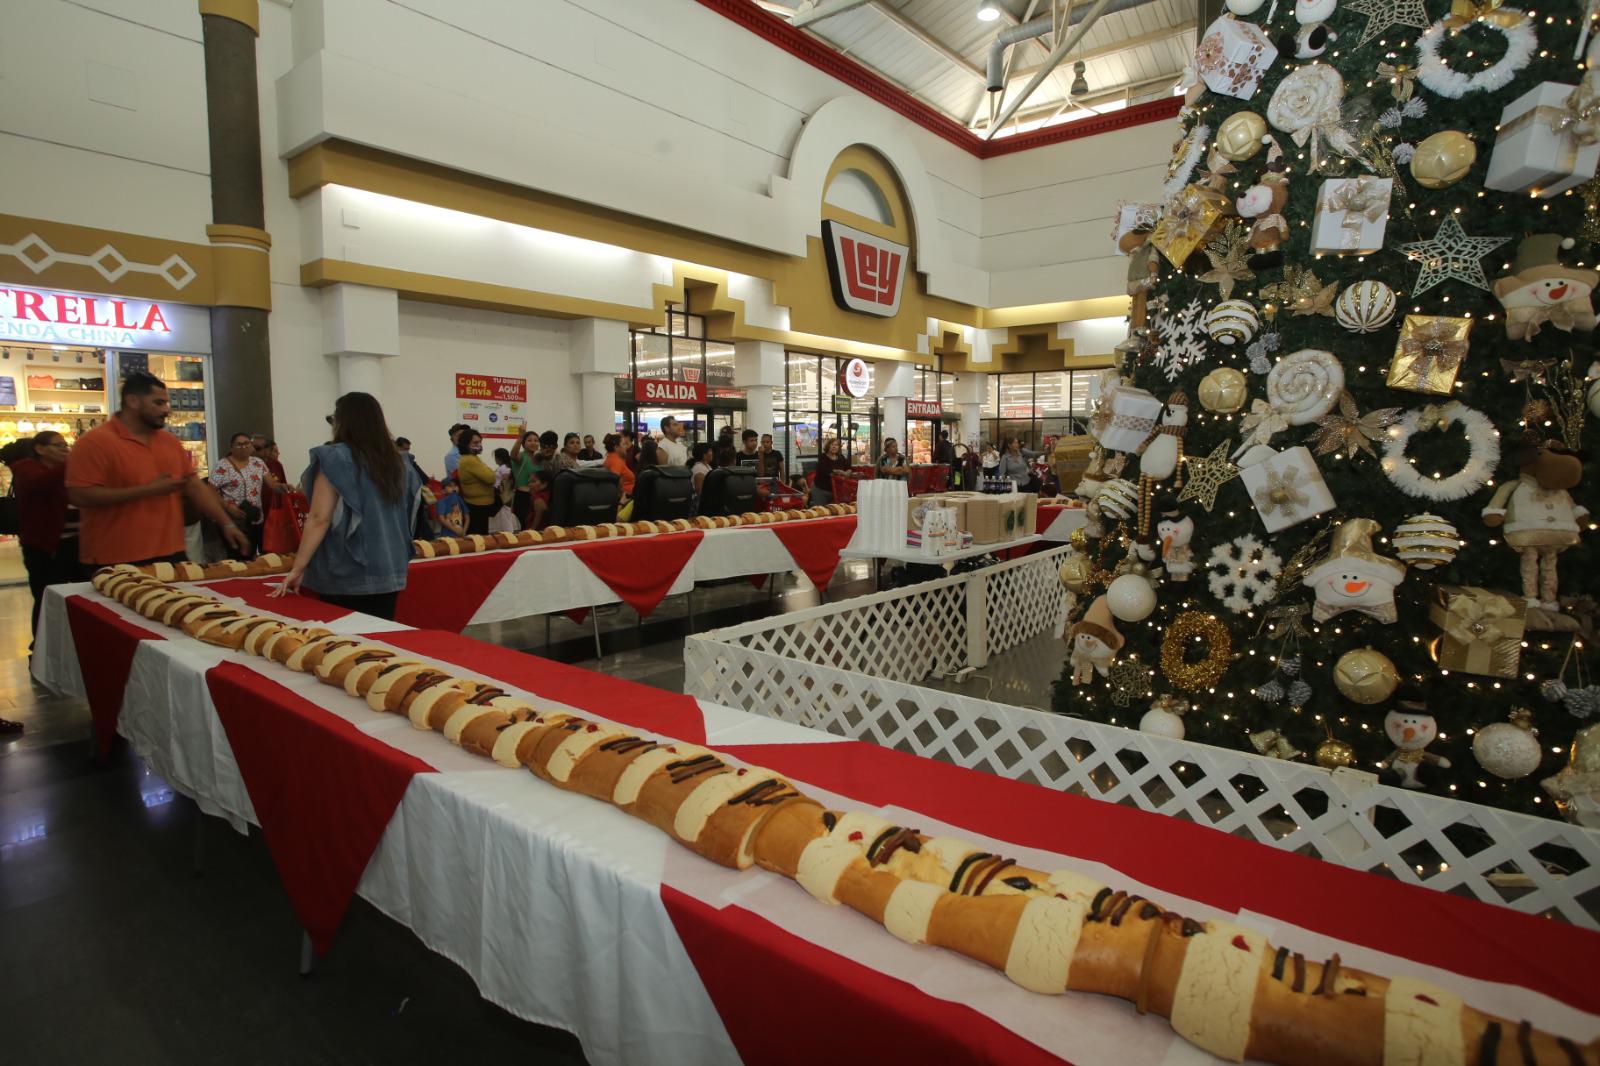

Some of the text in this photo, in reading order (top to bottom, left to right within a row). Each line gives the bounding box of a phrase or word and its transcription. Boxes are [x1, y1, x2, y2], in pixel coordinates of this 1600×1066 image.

[68, 327, 137, 344] CHINA
[459, 377, 487, 387] Cobra
[646, 382, 697, 400] SALIDA
[907, 402, 941, 415] ENTRADA
